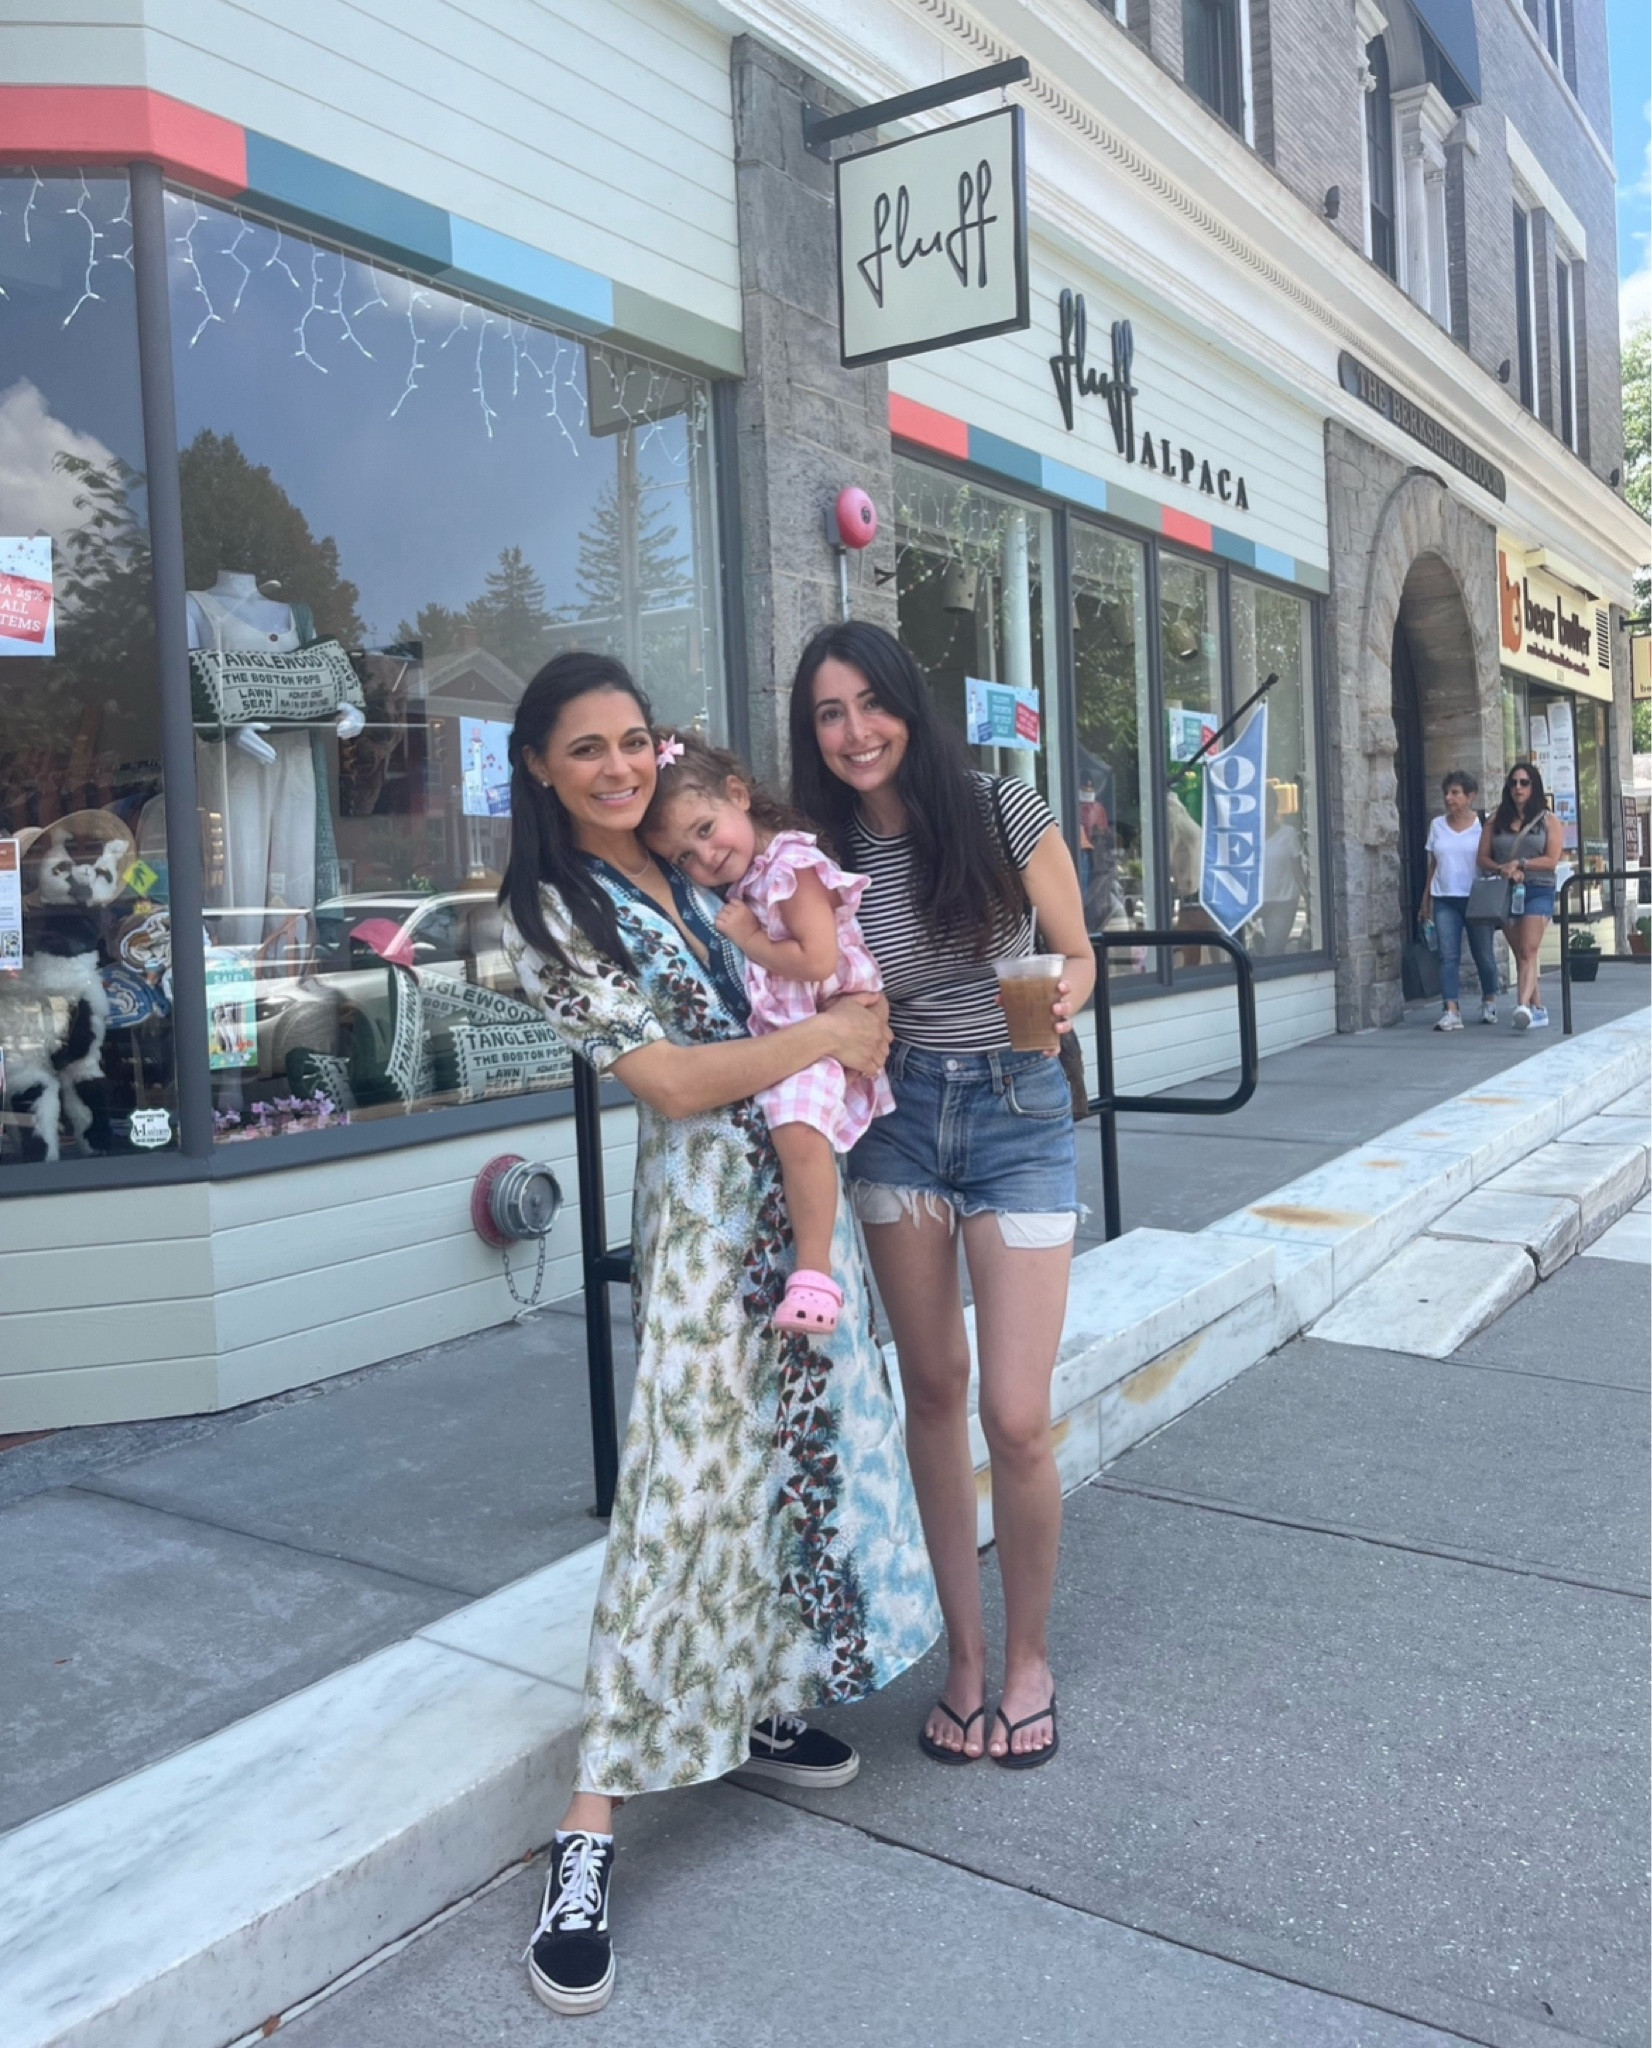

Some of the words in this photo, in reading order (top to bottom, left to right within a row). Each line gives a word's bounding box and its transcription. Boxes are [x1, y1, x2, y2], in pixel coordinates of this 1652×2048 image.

[857, 159, 997, 308] fluff
[1050, 288, 1138, 463] fluff
[1358, 368, 1387, 412] THE
[1140, 432, 1249, 510] ALPACA
[16, 587, 44, 603] 25%
[1, 599, 29, 615] ALL
[1523, 576, 1555, 640] bear
[0, 613, 42, 632] TEMS
[208, 652, 323, 670] TANGLEWOOD
[222, 673, 249, 685] THE
[250, 673, 295, 686] BOSTON
[298, 674, 321, 685] POPS
[238, 688, 273, 700] LAWN
[242, 699, 273, 711] SEAT
[1209, 755, 1257, 905] OPEN
[466, 1027, 557, 1050] TANGLEWO
[473, 1054, 499, 1067] THE
[502, 1049, 544, 1062] BOSTON
[486, 1067, 520, 1079] LAWN
